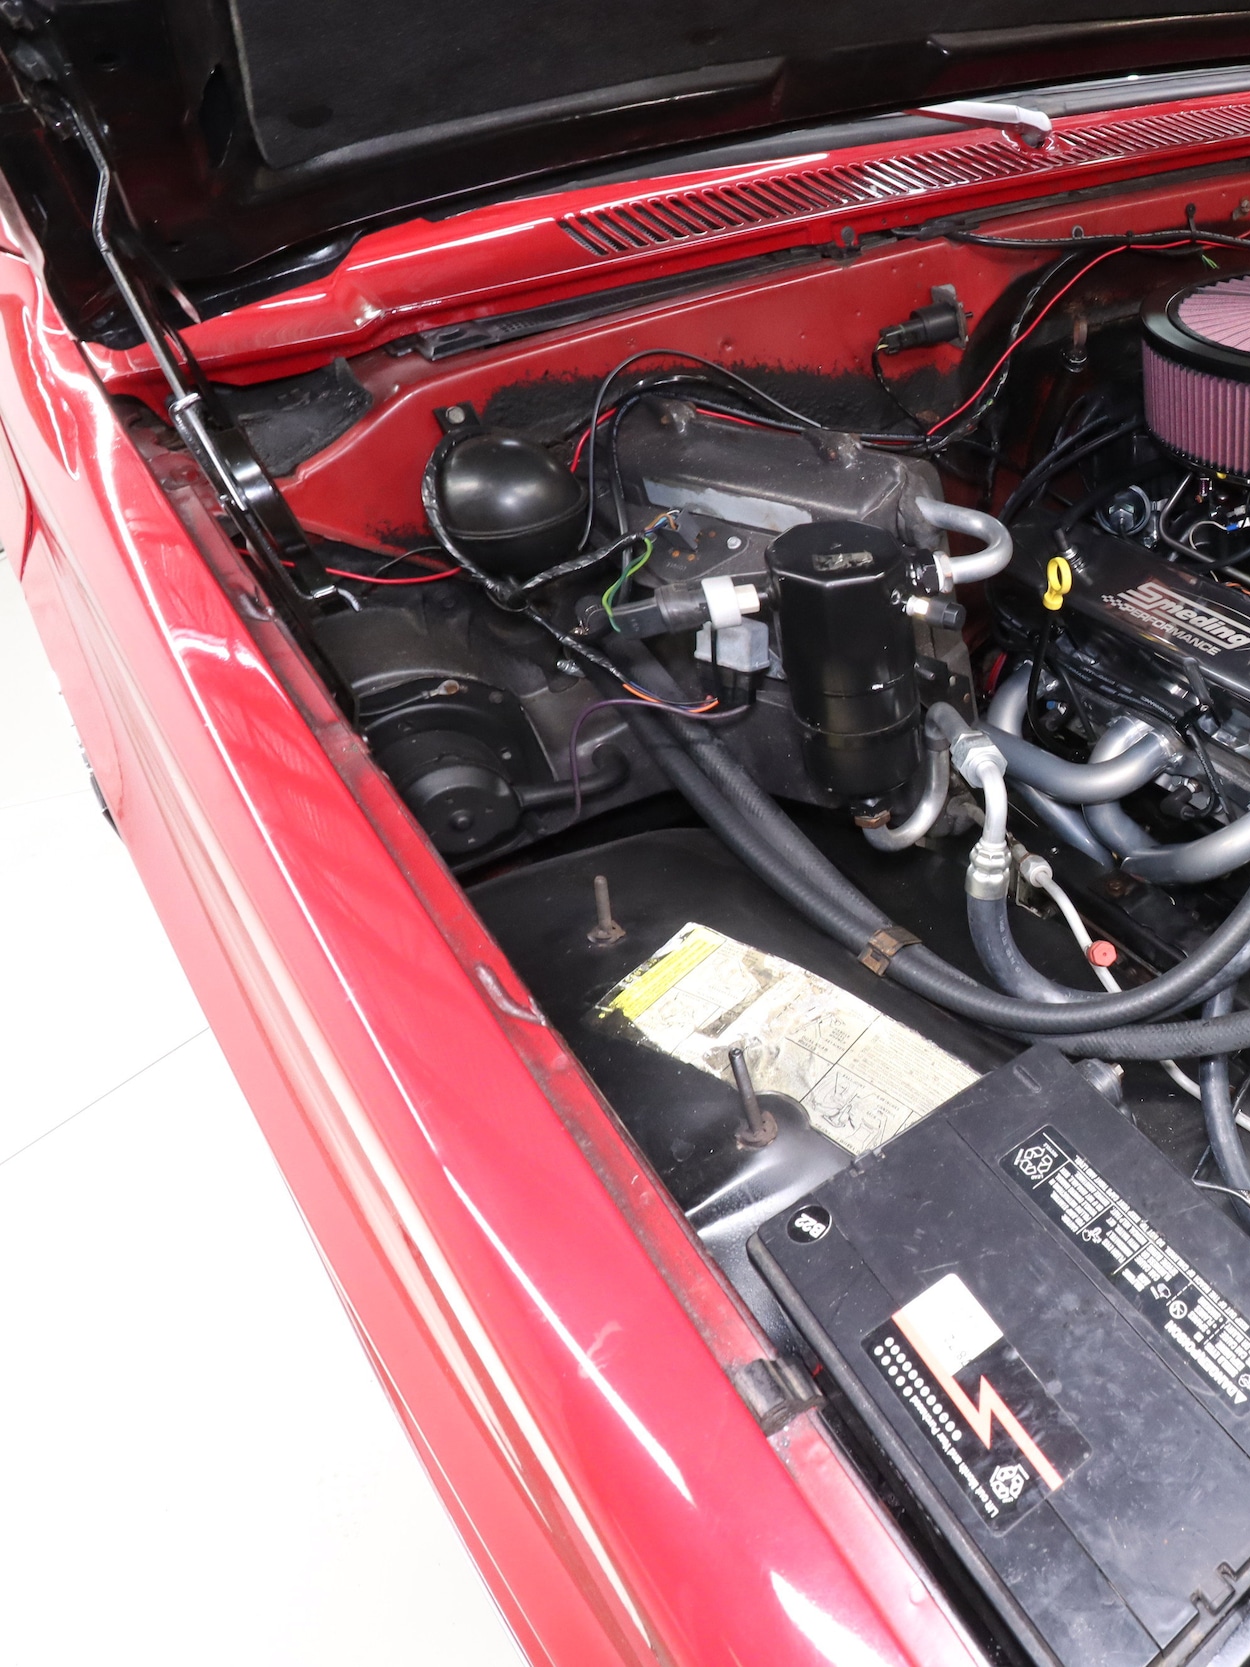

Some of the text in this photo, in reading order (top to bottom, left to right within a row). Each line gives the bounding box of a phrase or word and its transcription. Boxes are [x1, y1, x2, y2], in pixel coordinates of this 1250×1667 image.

[1122, 604, 1222, 656] PERFORMANCE
[794, 1212, 826, 1239] B22
[1164, 1320, 1239, 1398] DANGER/POISON
[909, 1395, 940, 1435] Purchased
[947, 1447, 962, 1464] and
[959, 1462, 979, 1490] Month
[975, 1486, 989, 1502] out
